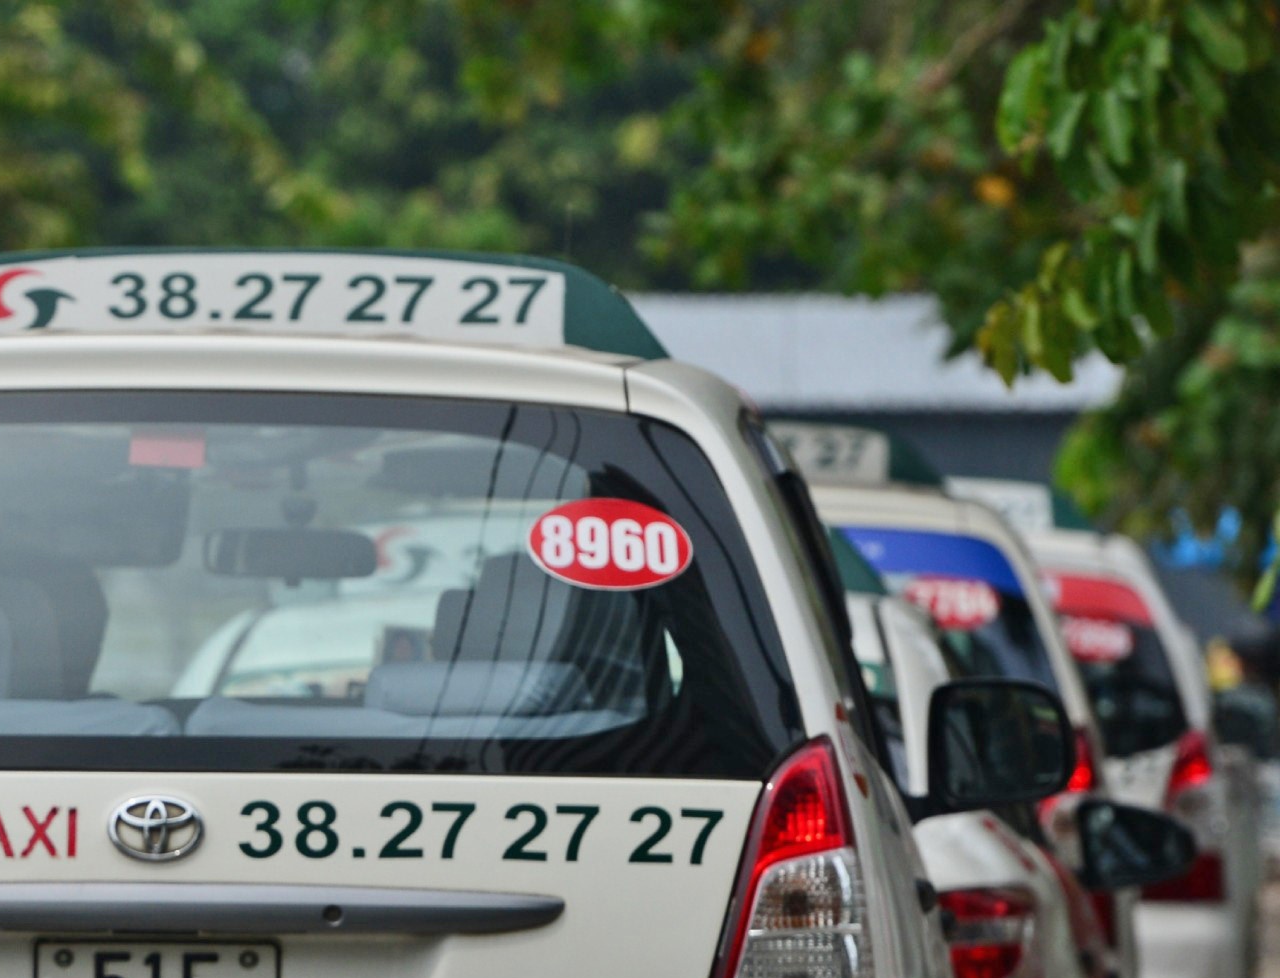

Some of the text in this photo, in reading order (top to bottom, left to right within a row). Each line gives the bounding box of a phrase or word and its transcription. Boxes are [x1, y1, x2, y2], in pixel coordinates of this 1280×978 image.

[109, 272, 548, 325] 38.27 27 27
[540, 514, 680, 576] 8960
[238, 800, 477, 860] 38.27
[501, 802, 600, 863] 27
[627, 805, 725, 866] 27
